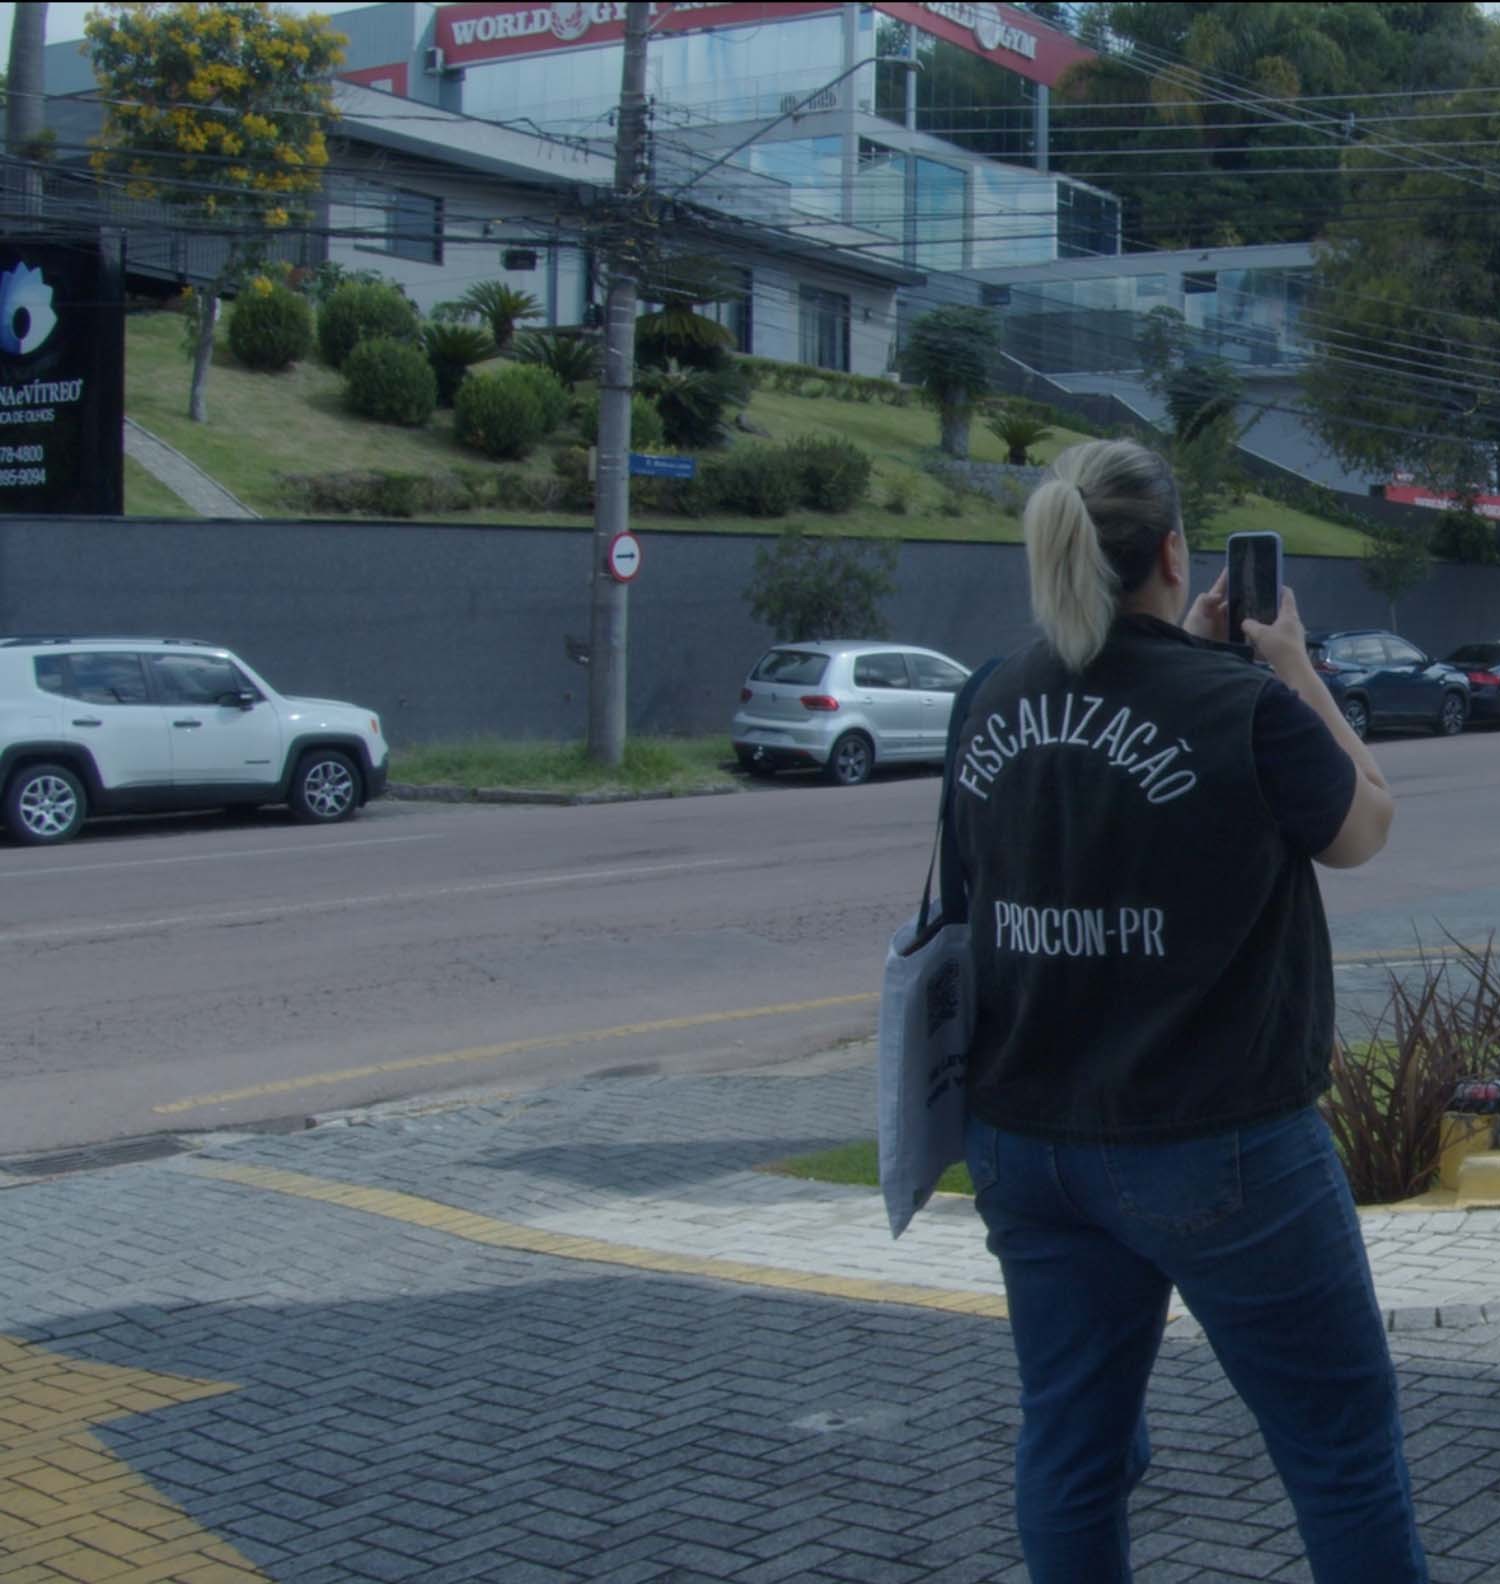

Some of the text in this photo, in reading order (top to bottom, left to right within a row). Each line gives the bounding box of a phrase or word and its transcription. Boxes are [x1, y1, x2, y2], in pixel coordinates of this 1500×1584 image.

[451, 9, 553, 46] WORLD
[999, 22, 1037, 61] GYM
[25, 408, 55, 423] OLHOS
[958, 691, 1197, 805] FISCALIZAÇÃO
[994, 899, 1166, 958] PROCON-PR
